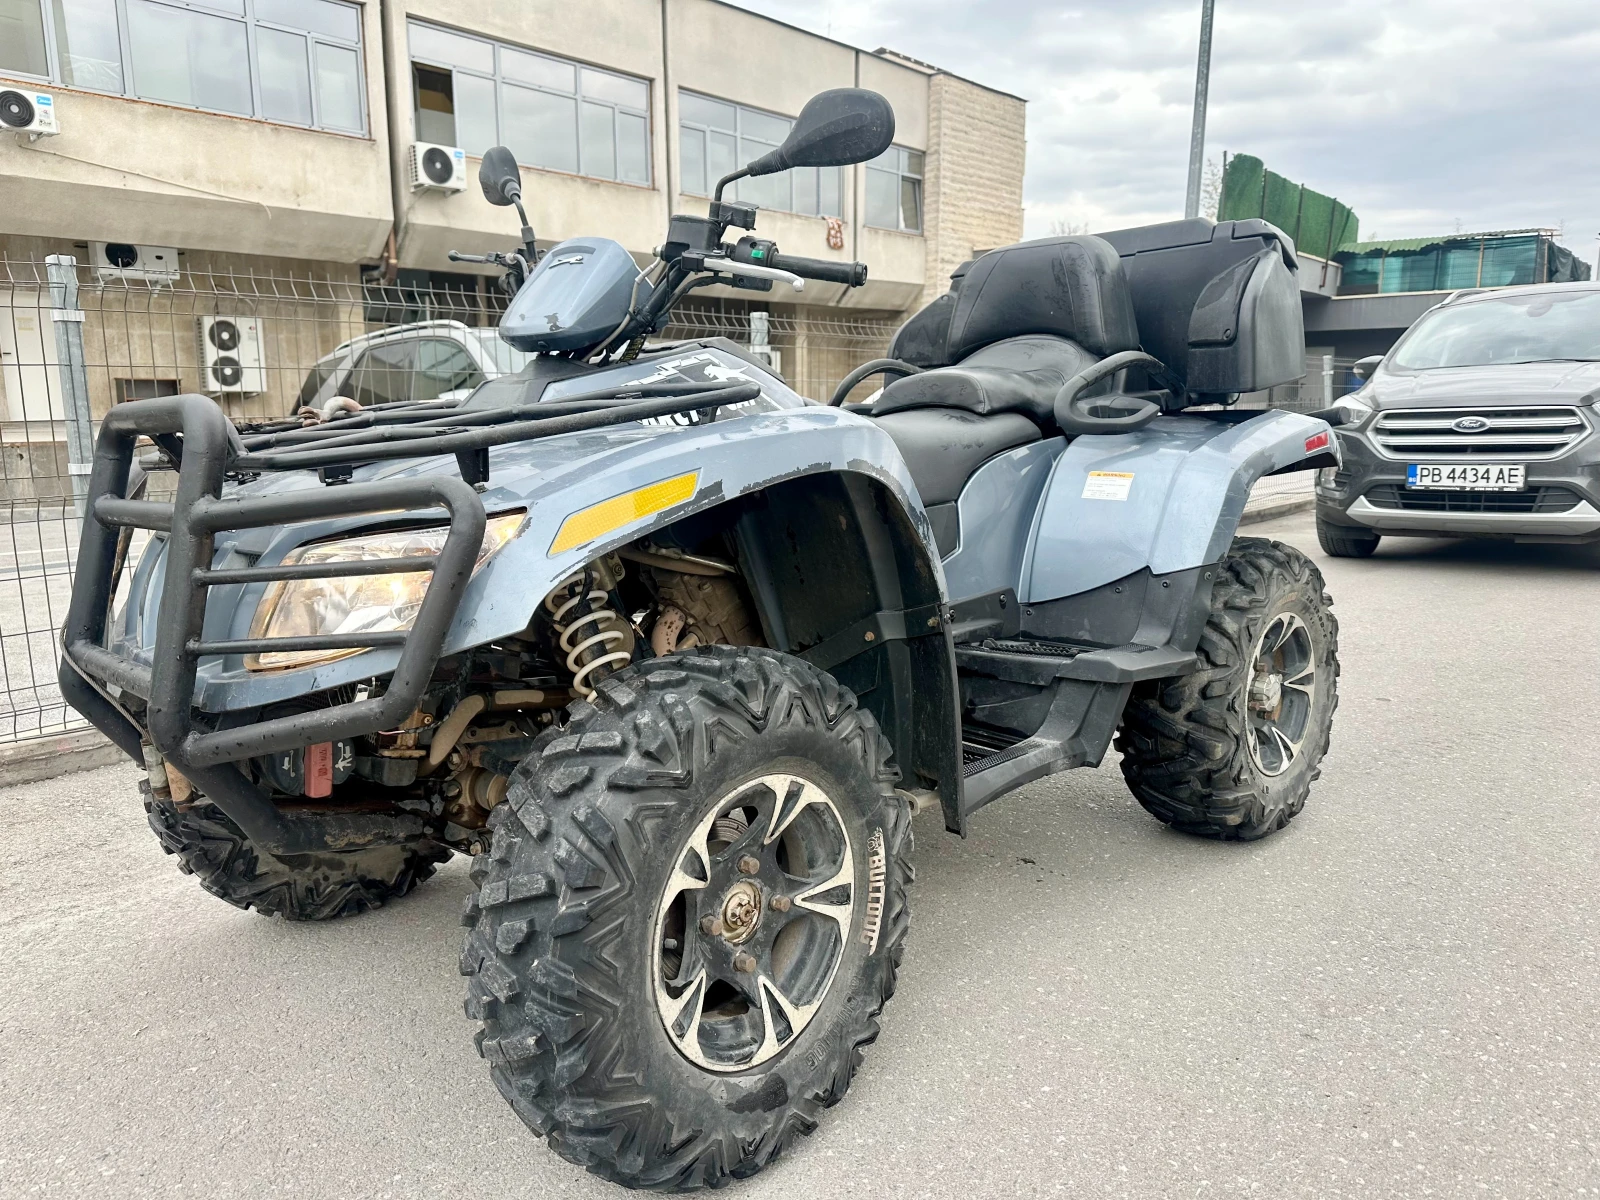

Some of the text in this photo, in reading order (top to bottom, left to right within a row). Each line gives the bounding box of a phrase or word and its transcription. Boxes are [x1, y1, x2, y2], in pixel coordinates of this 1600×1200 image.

[1459, 420, 1481, 429] Ford
[1420, 467, 1520, 484] PB 4434 AE
[860, 854, 886, 947] BULLDOG
